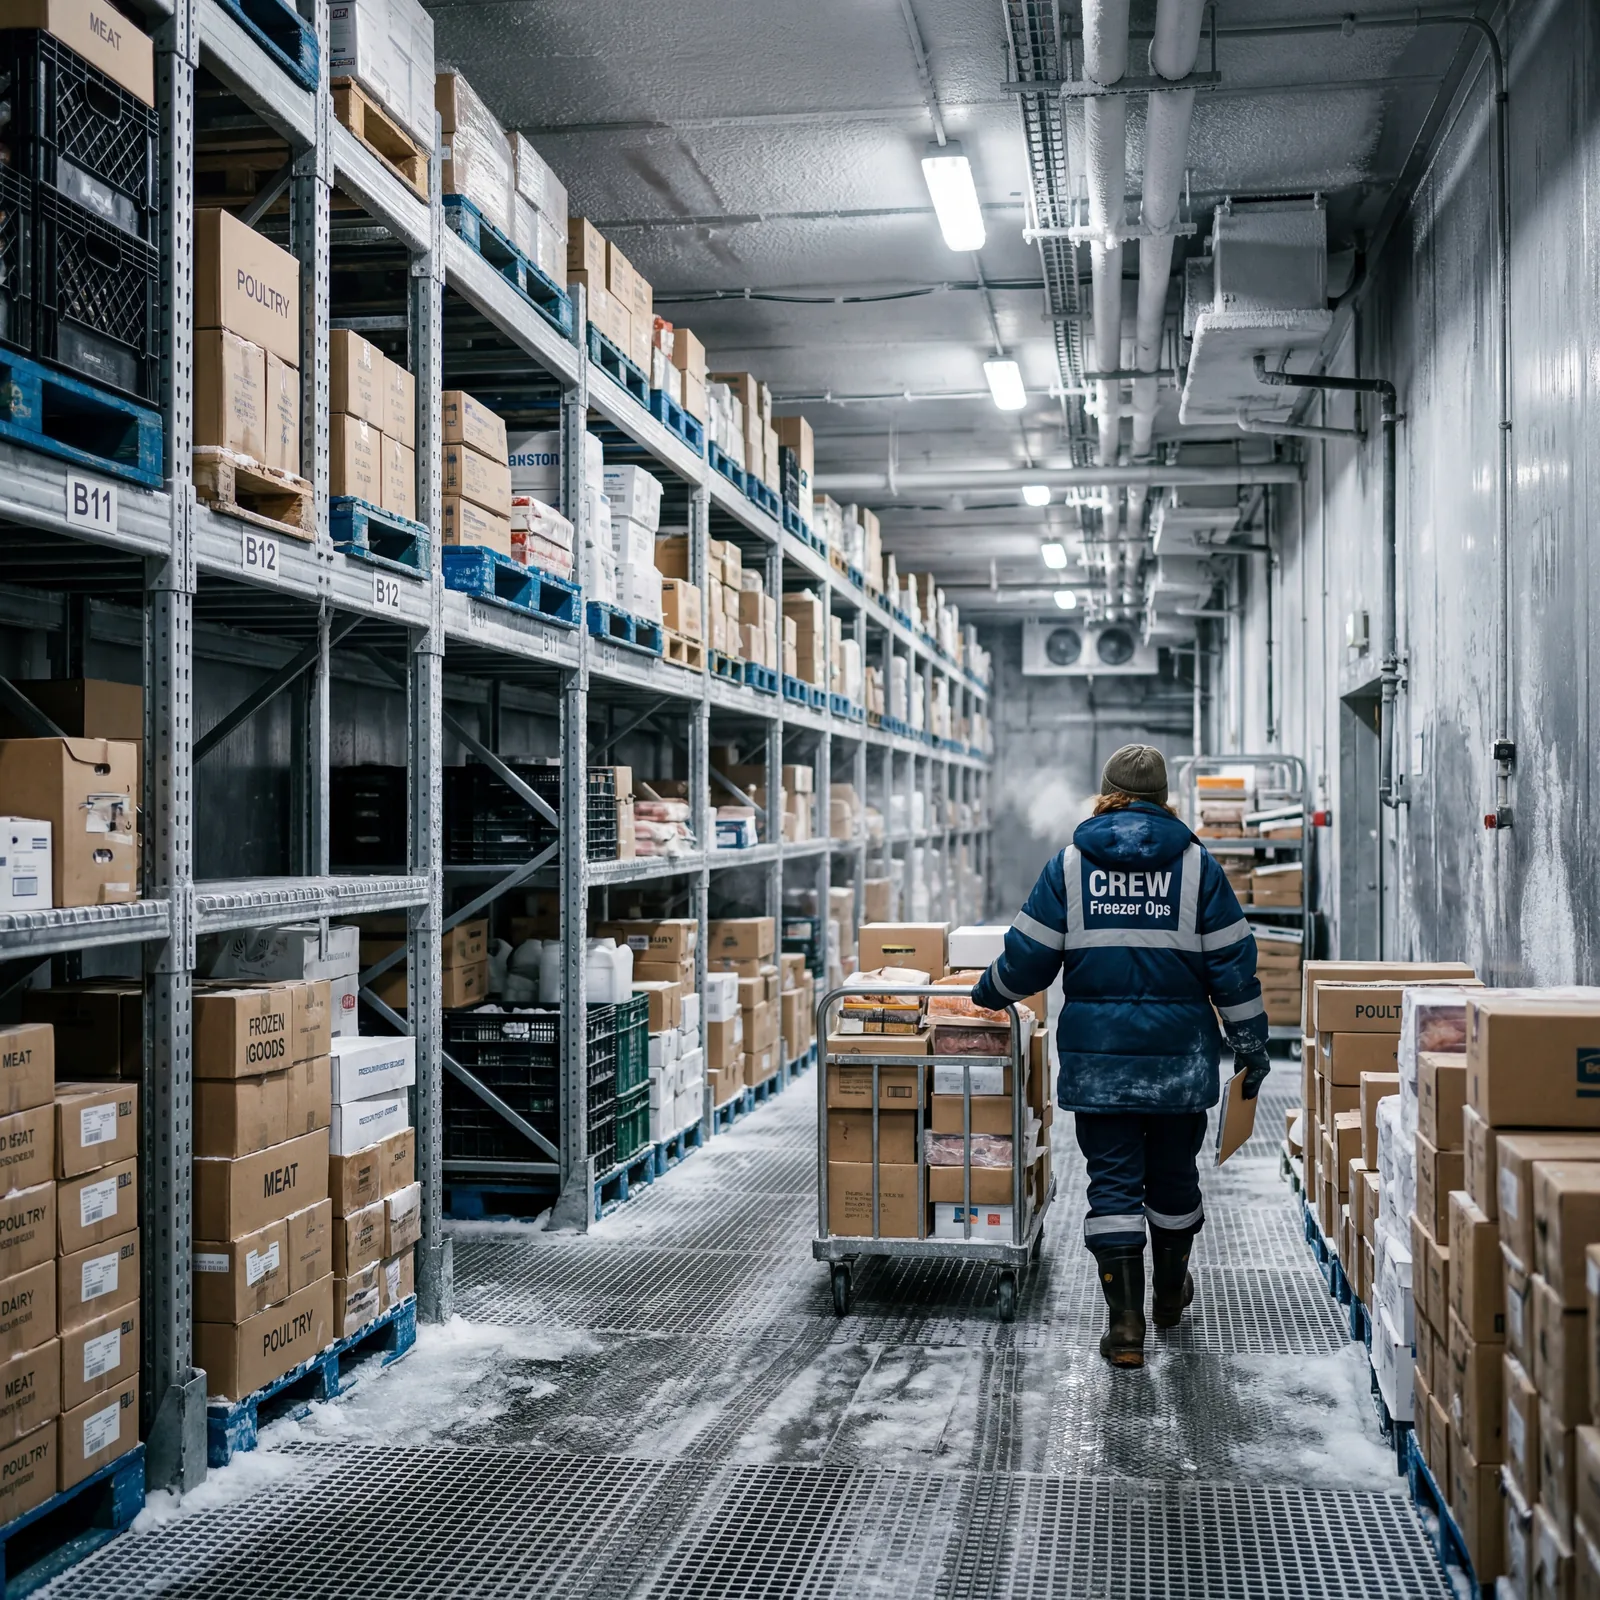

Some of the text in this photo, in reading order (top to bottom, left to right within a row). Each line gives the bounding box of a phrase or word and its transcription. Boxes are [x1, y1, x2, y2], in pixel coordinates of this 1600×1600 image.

[90, 12, 121, 51] MEAT
[237, 268, 290, 319] POULTRY
[74, 481, 110, 522] B11
[246, 536, 276, 571] B12
[376, 578, 399, 607] B12
[1088, 869, 1172, 898] CREW
[1090, 900, 1171, 918] Freezer Ops
[249, 1012, 285, 1036] FROZEN
[1355, 1004, 1402, 1019] POULT
[3, 1050, 32, 1069] MEAT
[264, 1162, 299, 1198] MEAT
[0, 1205, 47, 1235] POULTRY
[2, 1289, 34, 1316] DAIRY
[263, 1309, 314, 1357] POULTRY
[5, 1371, 35, 1400] MEAT
[3, 1441, 49, 1480] POULTRY
